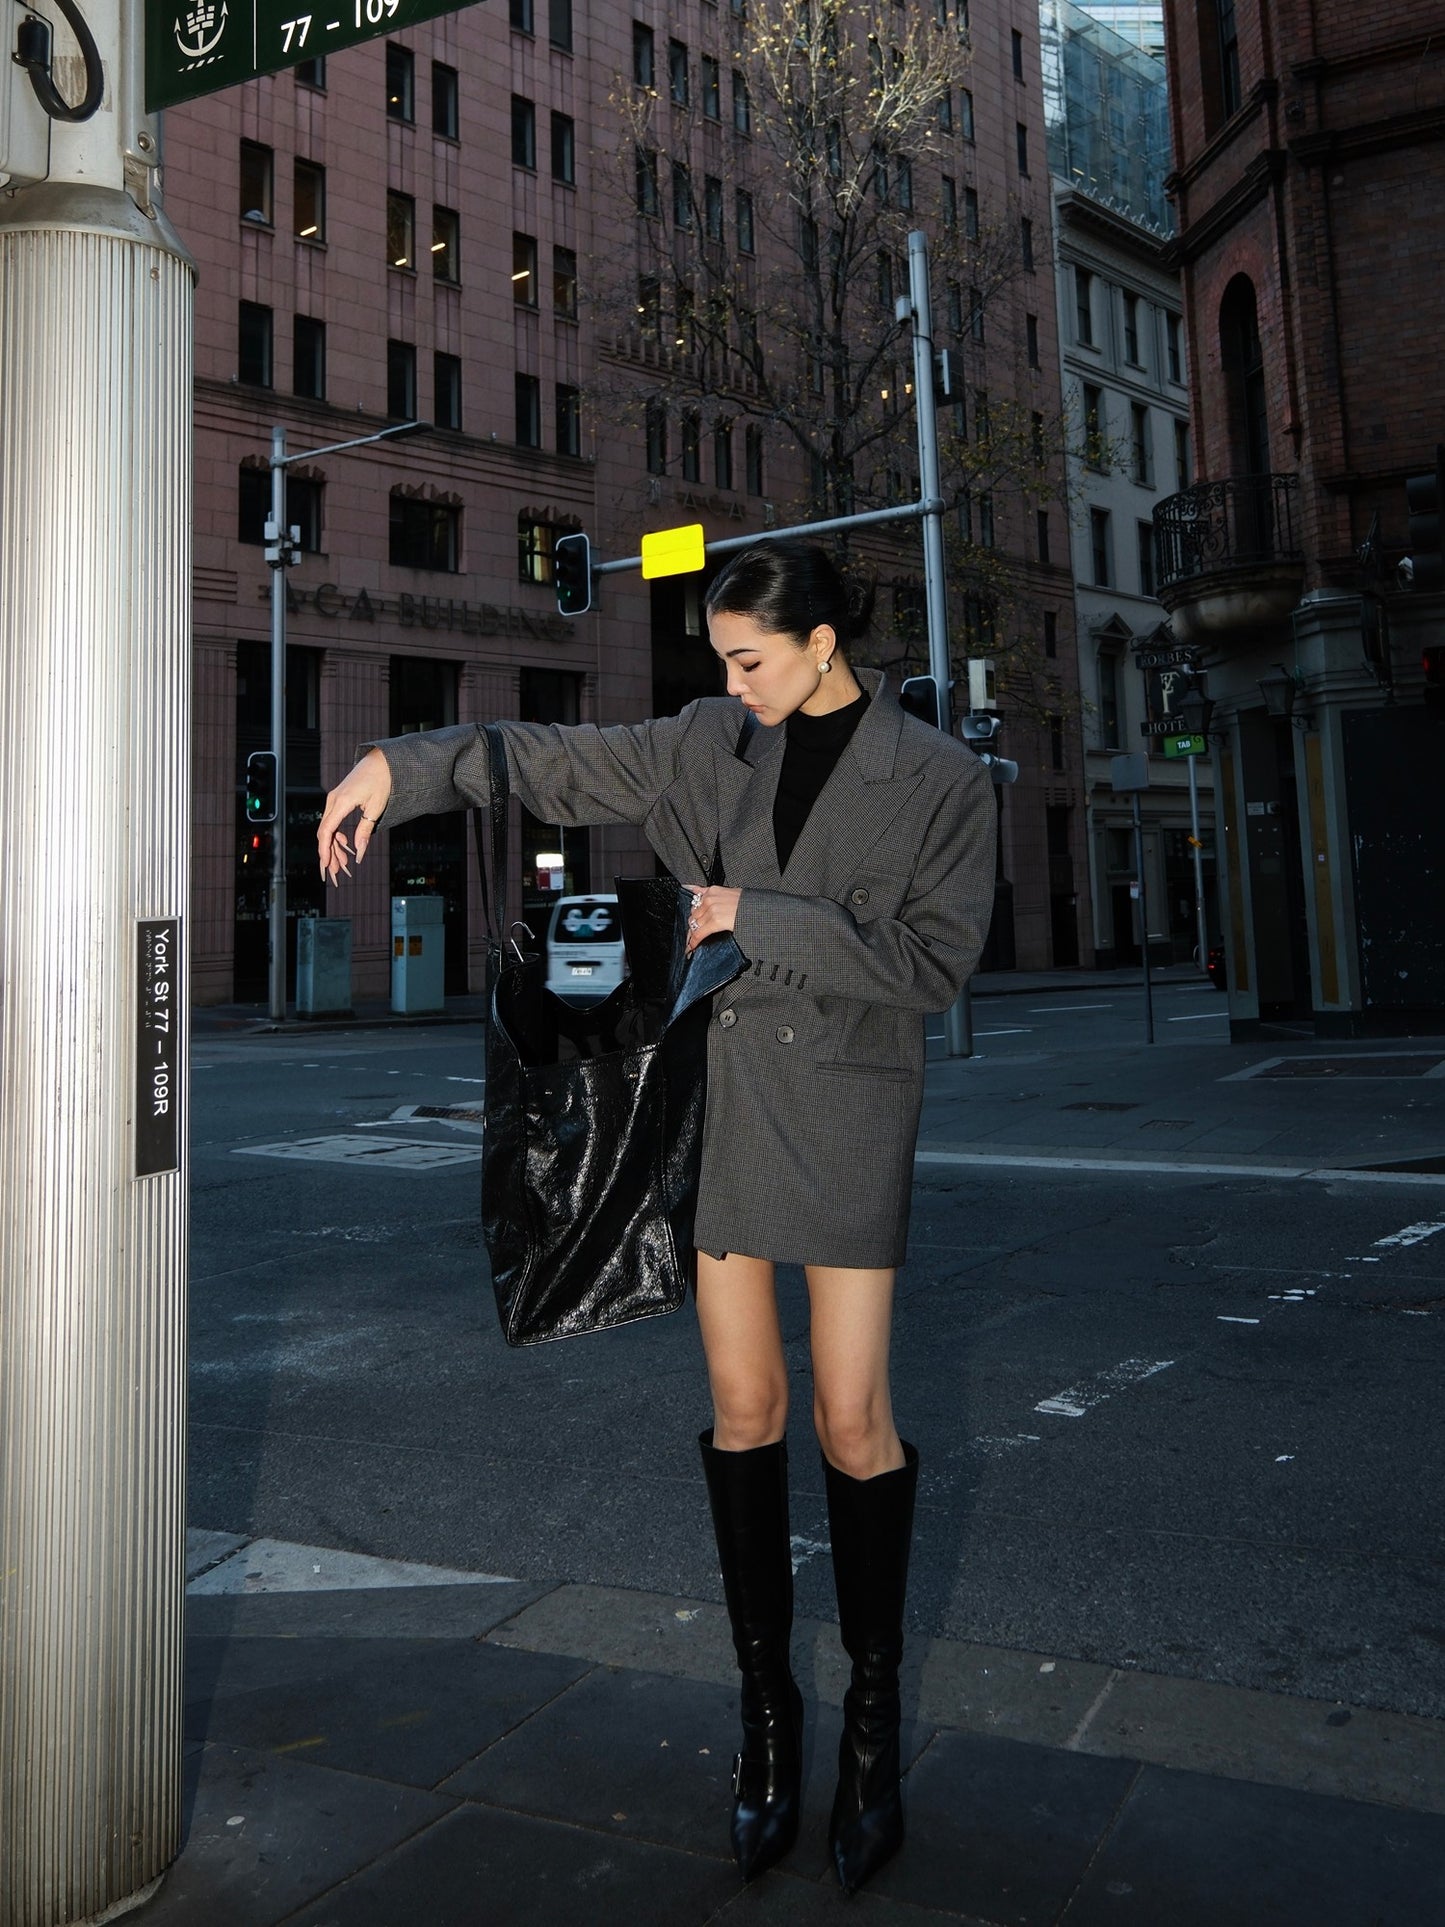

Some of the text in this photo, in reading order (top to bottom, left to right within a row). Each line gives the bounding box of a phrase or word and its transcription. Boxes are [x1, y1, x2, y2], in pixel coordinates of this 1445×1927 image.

[280, 15, 313, 53] 77
[355, 0, 400, 29] 109
[1147, 719, 1187, 734] HOTE
[1176, 740, 1191, 749] TAB
[154, 928, 170, 975] York
[154, 981, 170, 1003] St
[154, 1008, 170, 1033] 77
[153, 1062, 170, 1117] 109R
